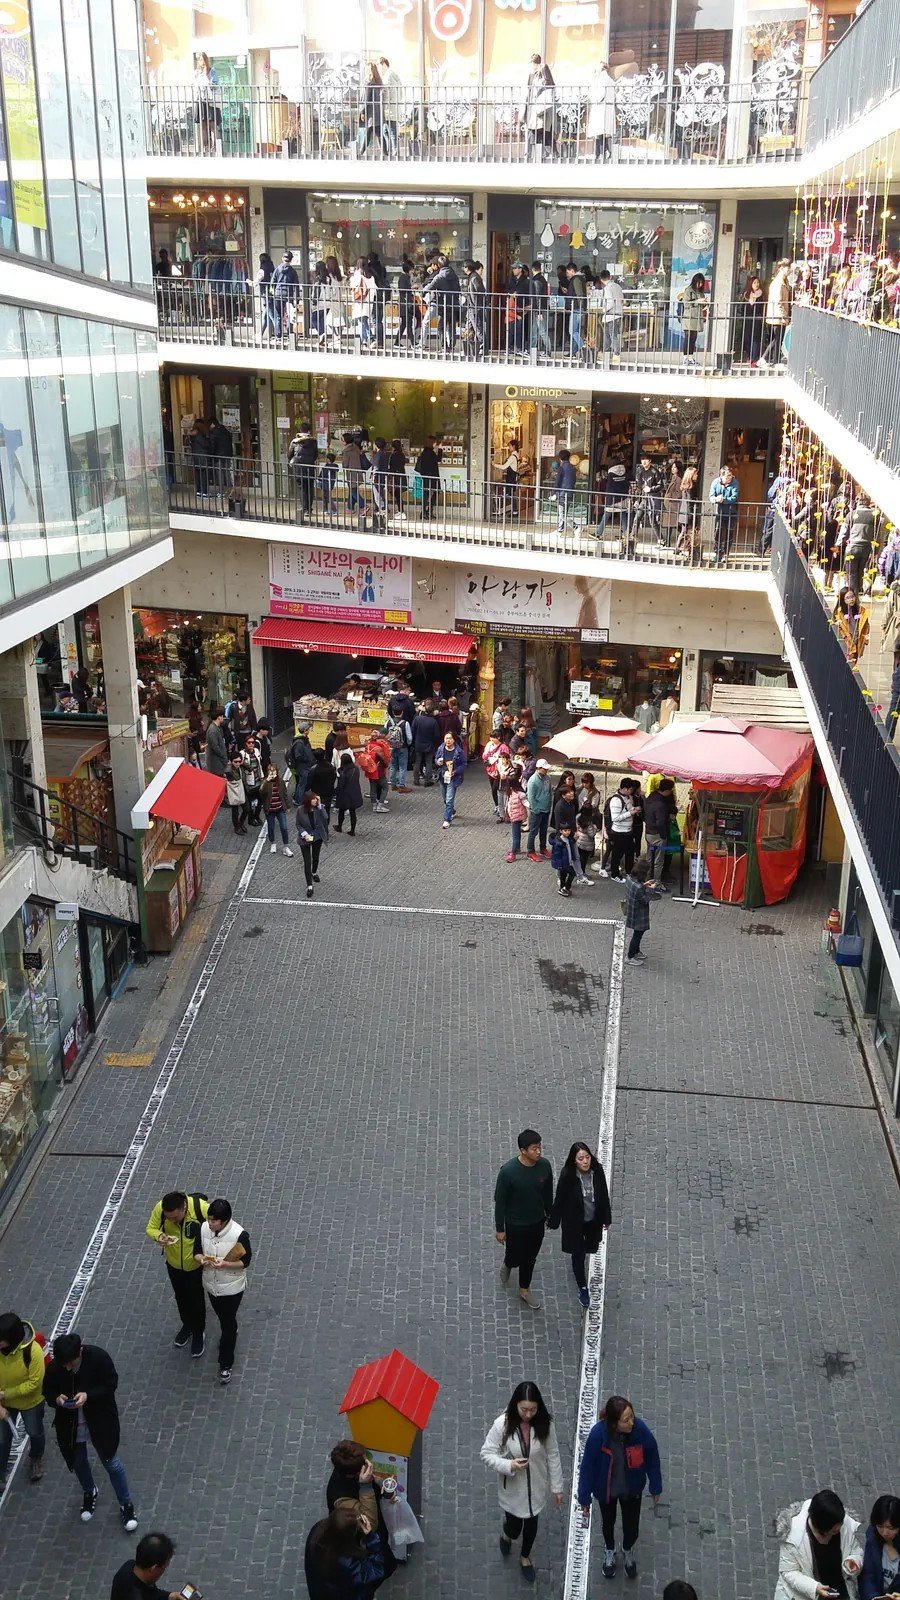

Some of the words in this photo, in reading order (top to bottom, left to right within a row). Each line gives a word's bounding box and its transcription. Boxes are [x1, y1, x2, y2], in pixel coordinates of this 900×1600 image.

[520, 387, 562, 398] indimap
[307, 550, 352, 570] 시간의
[373, 555, 403, 573] 나이
